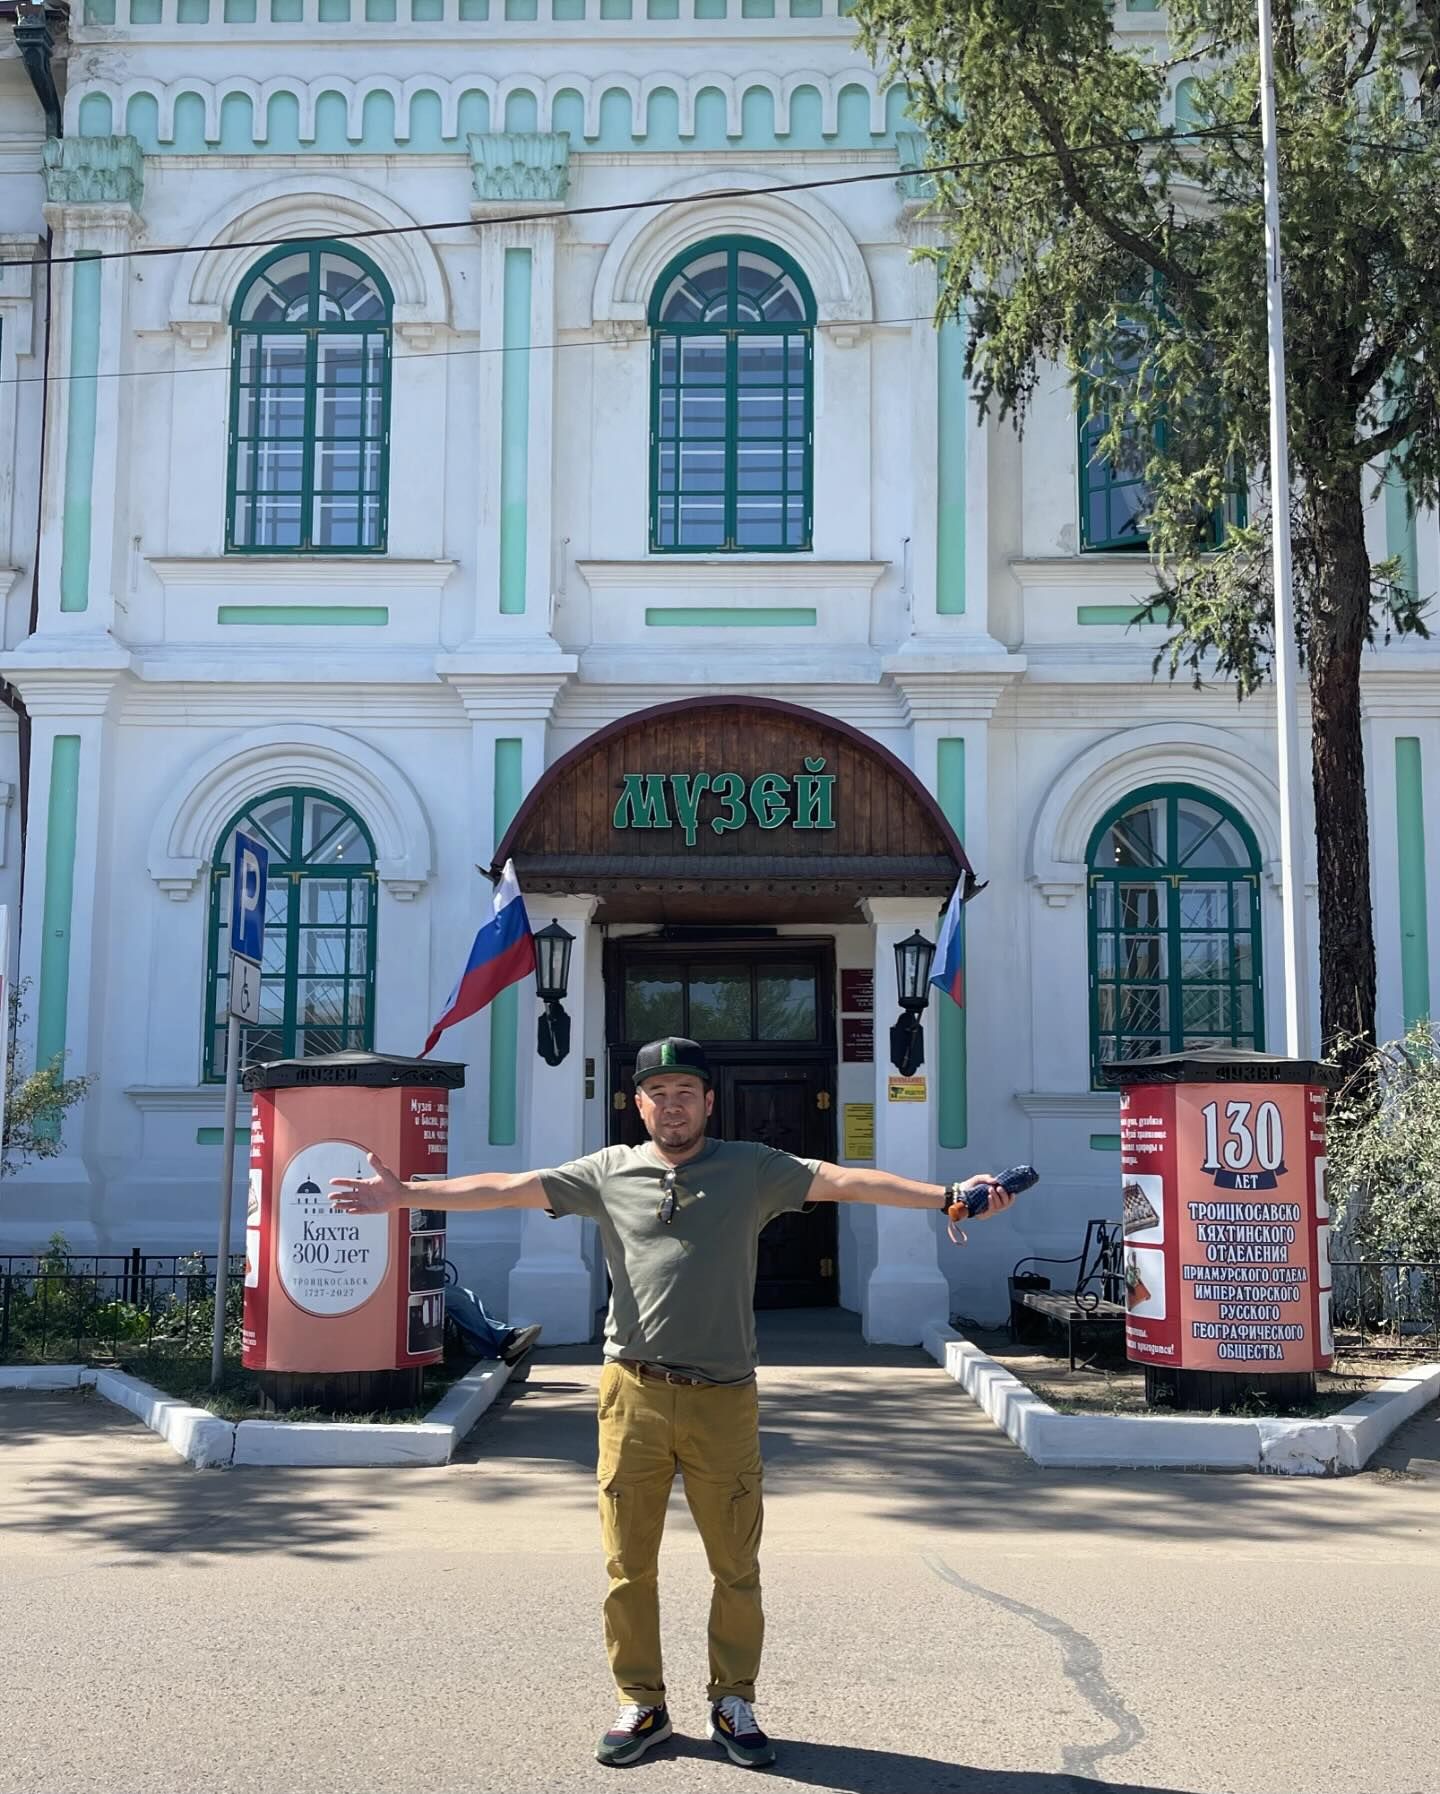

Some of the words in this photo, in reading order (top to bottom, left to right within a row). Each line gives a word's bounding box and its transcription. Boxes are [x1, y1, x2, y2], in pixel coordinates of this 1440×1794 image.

[613, 756, 836, 847] МУЗЕЙ
[240, 848, 260, 941] P
[1201, 1100, 1283, 1169] 130
[1235, 1174, 1258, 1189] ЛЕТ
[1188, 1202, 1300, 1222] ТРОИЦКОСАВСКО
[304, 1220, 359, 1241] Кяхта
[1197, 1224, 1295, 1243] КЯХТИНСКОГО
[292, 1242, 329, 1264] 300
[333, 1248, 370, 1264] лет
[1207, 1244, 1288, 1264] ОТДЕЛЕНИЯ
[1183, 1265, 1269, 1282] ПРИАМУРСКОГО
[1271, 1268, 1307, 1283] ОТДЕЛА
[304, 1288, 354, 1297] 1727-2027
[1194, 1284, 1300, 1302] ИМПЕРАТОРСКОГО
[1220, 1304, 1280, 1321] РУССКОГО
[1192, 1322, 1304, 1341] ГЕОГРАФИЧЕСКОГО
[1218, 1342, 1283, 1361] ОБЩЕСТВА
